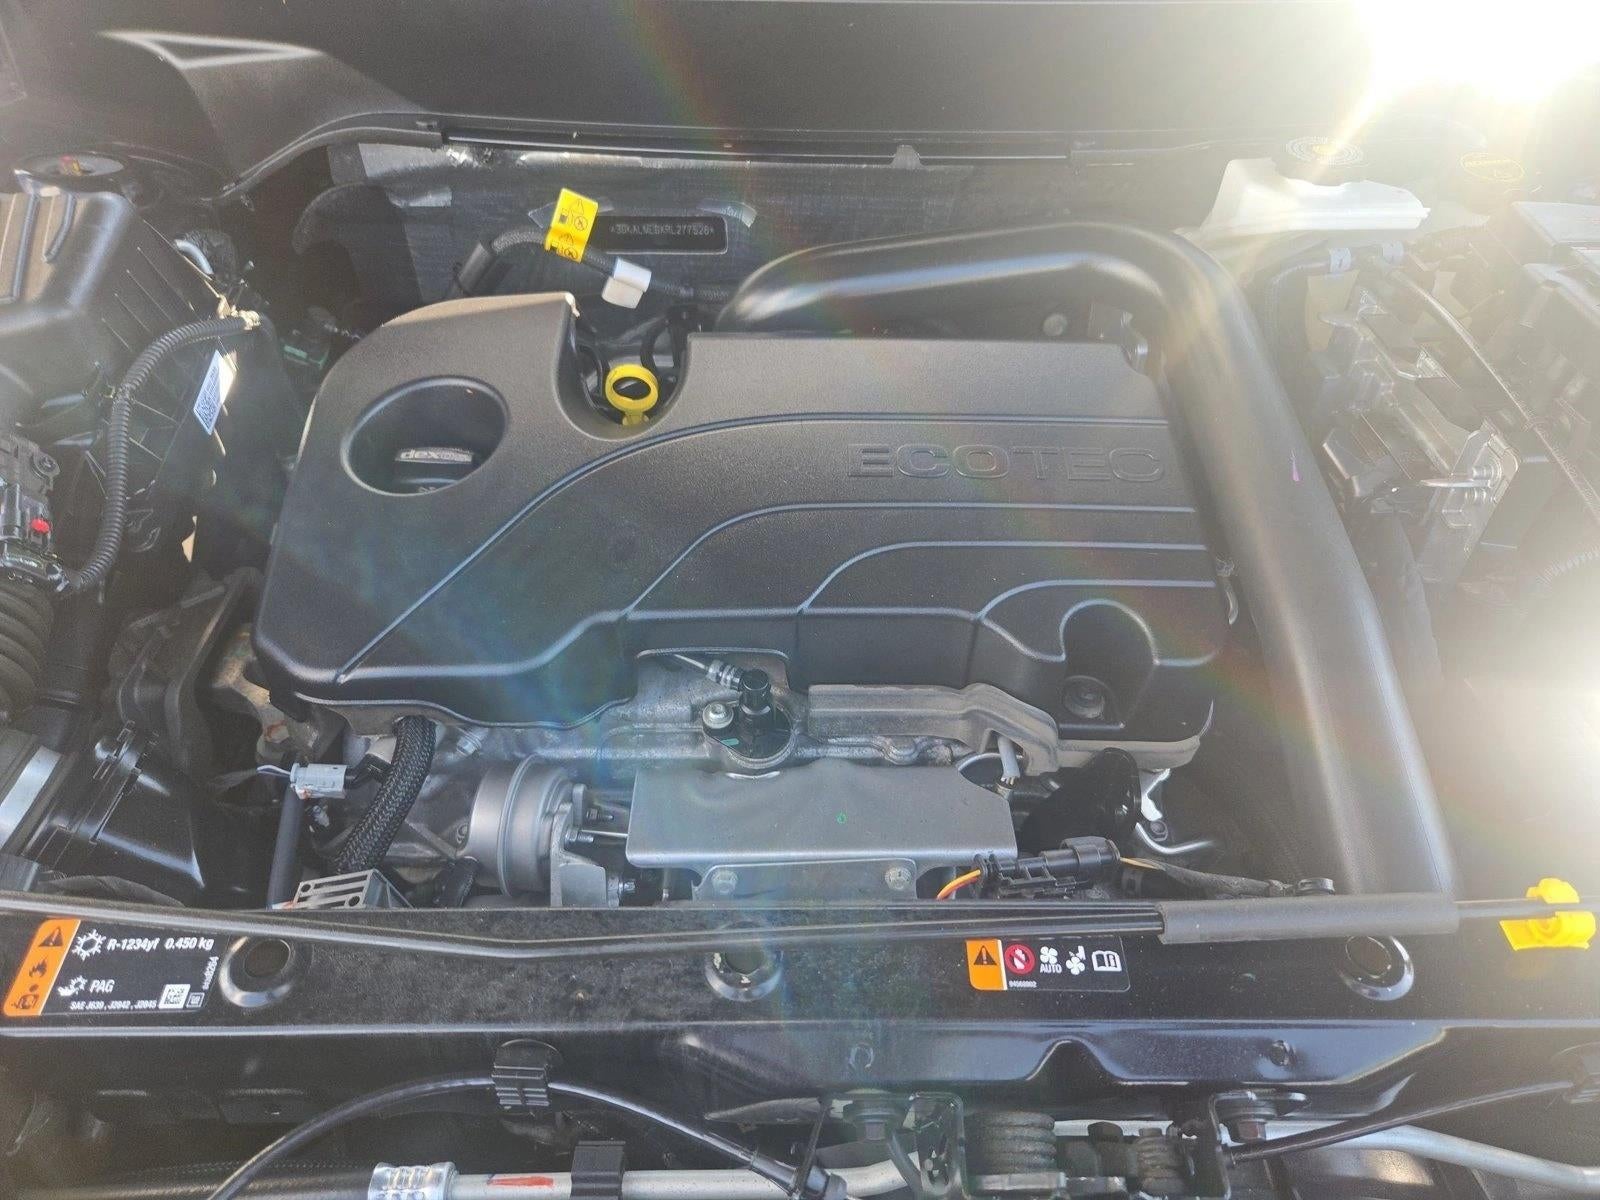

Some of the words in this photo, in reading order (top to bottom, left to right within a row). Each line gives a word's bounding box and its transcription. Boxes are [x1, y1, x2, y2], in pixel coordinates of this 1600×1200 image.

[847, 443, 1165, 482] ECOTEC
[107, 938, 160, 952] R-1234yf
[164, 937, 197, 950] 0.450
[198, 937, 214, 951] kg
[1040, 964, 1062, 974] AUTO
[89, 979, 115, 993] PAG
